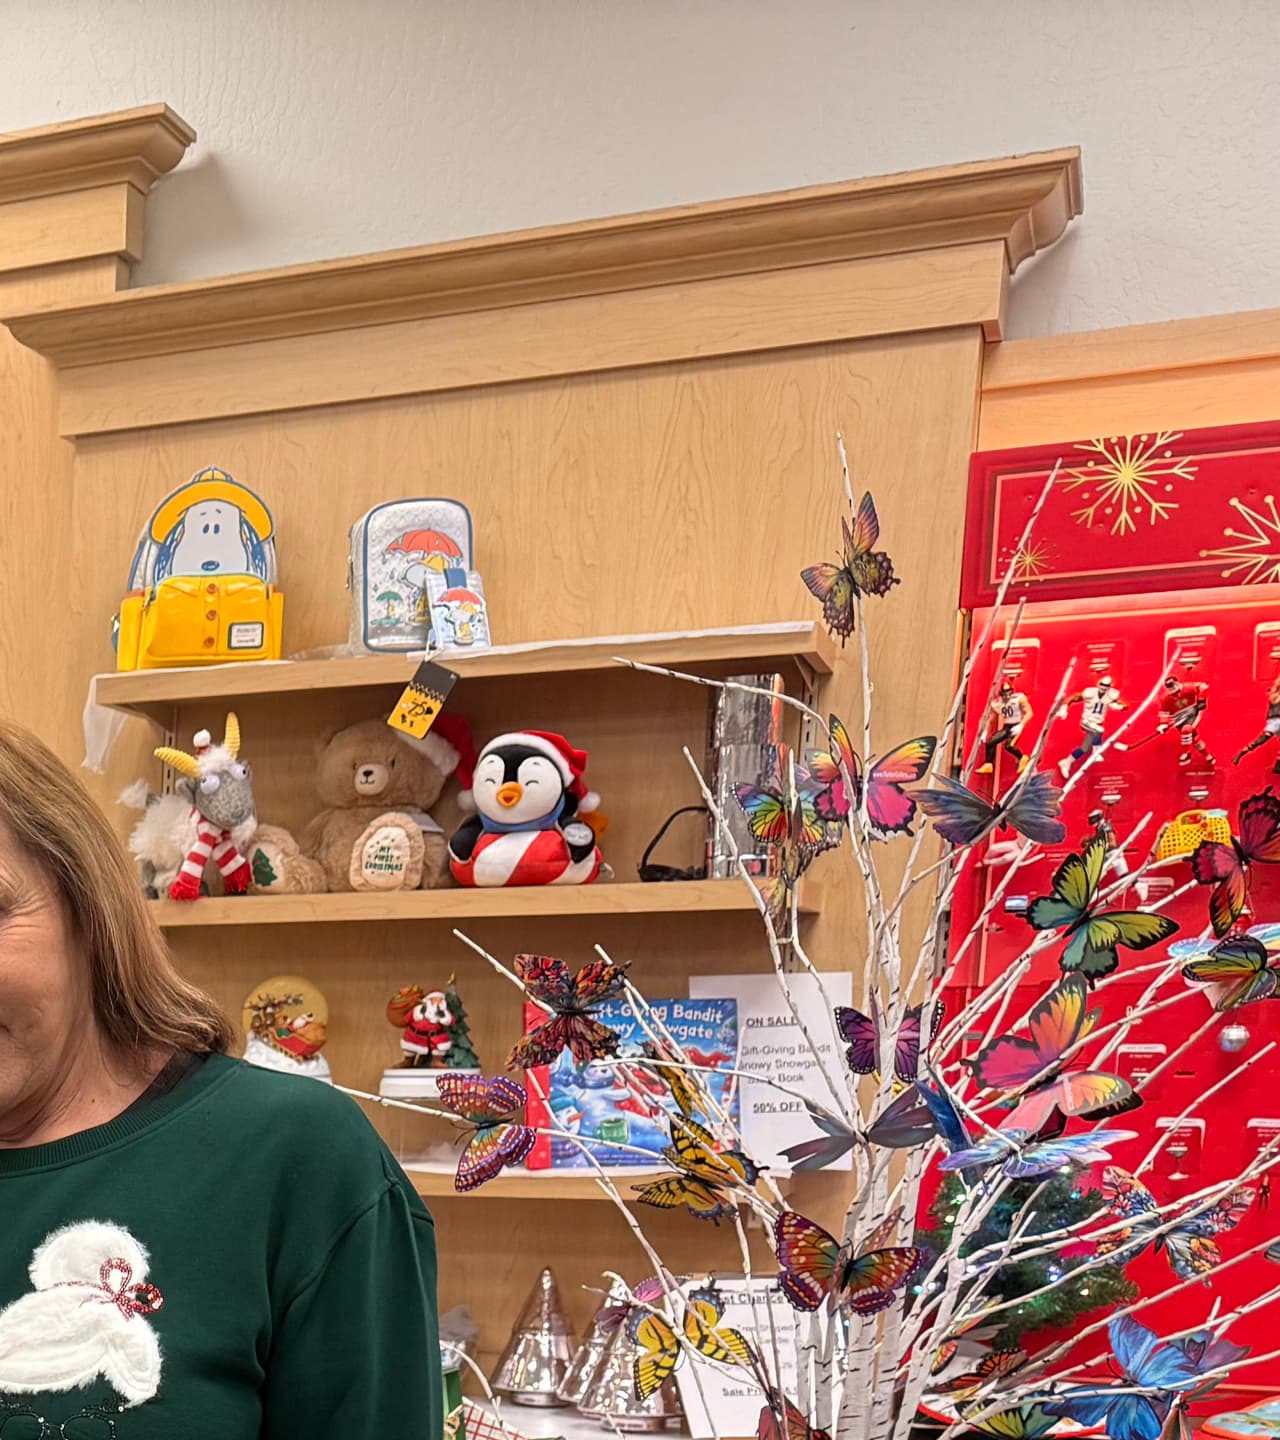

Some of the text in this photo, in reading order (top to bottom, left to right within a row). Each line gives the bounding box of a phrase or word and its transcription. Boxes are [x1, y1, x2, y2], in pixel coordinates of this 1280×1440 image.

[673, 1004, 724, 1024] Bandit
[746, 1017, 764, 1027] ON
[798, 1043, 831, 1054] Badit
